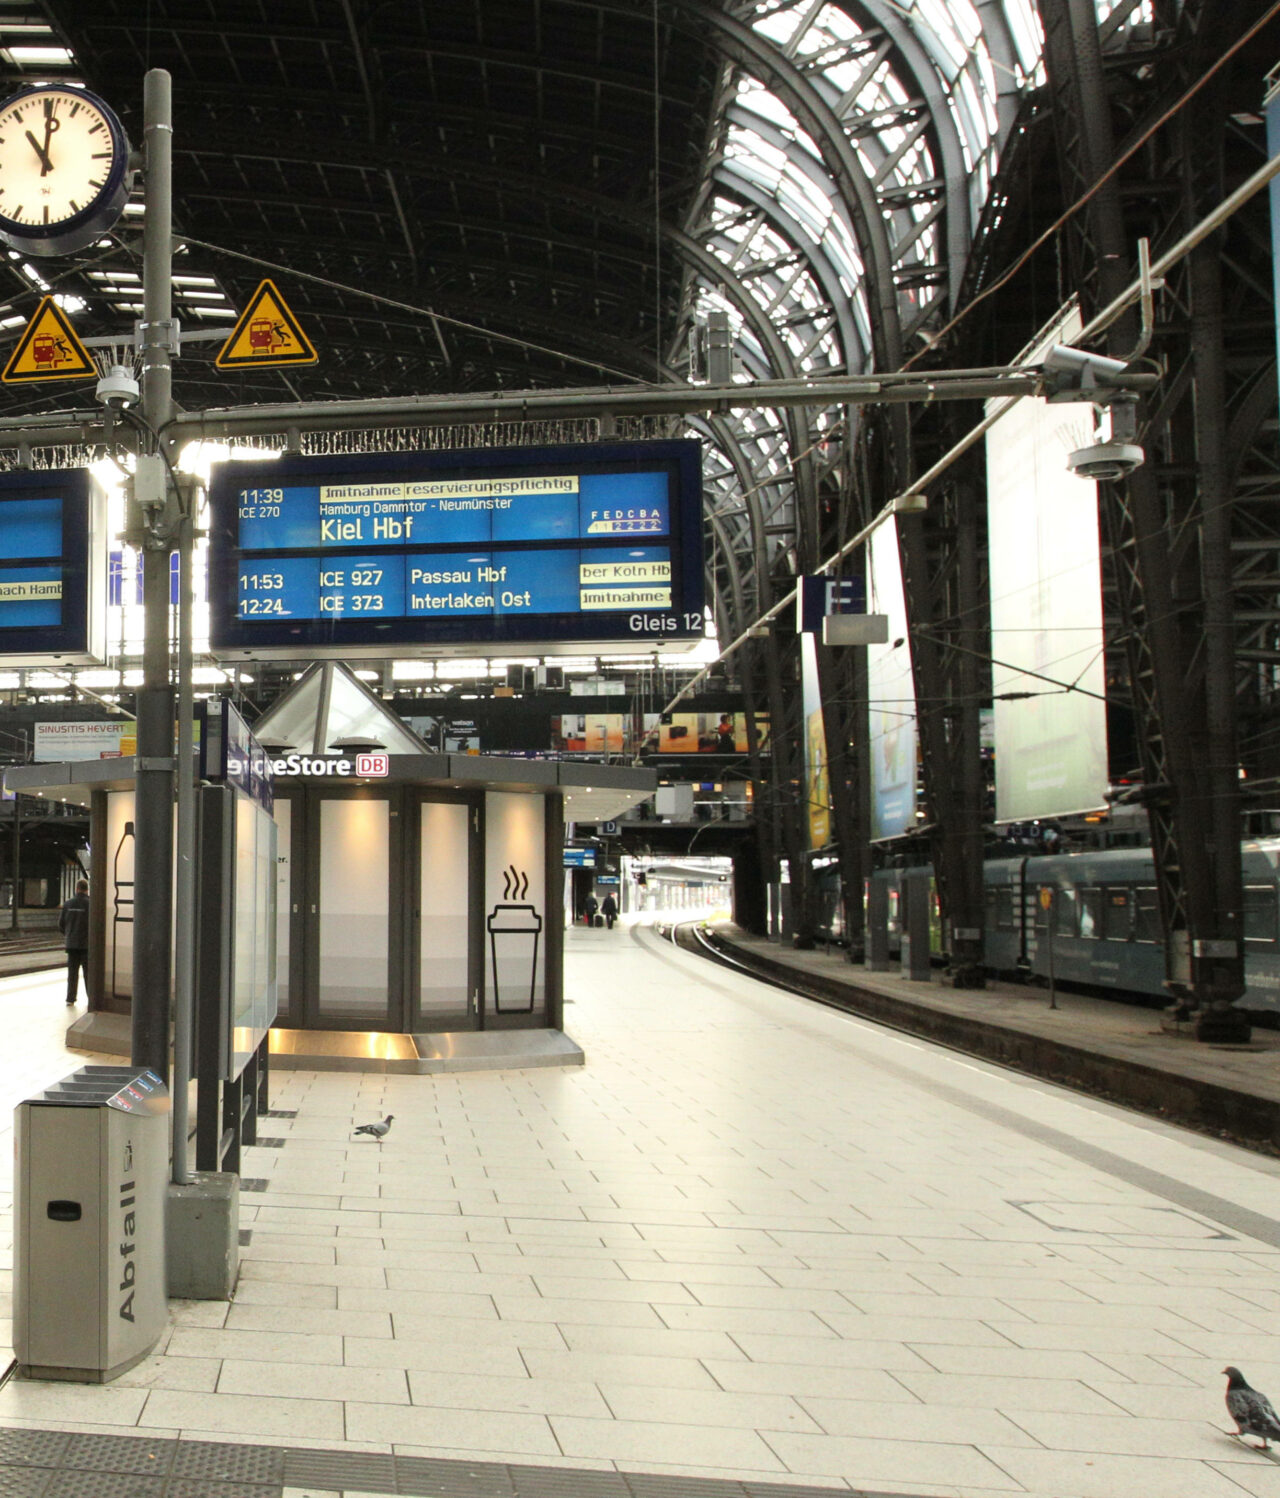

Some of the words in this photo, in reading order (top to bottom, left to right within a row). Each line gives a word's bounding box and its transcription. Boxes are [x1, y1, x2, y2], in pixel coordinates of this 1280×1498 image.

[406, 479, 573, 495] reservierungspflichtig
[240, 488, 284, 504] 11:39
[239, 507, 256, 519] ICE
[259, 506, 280, 518] 270
[320, 504, 370, 517] Hamburg
[373, 502, 427, 514] Dammtor
[440, 498, 513, 511] Neumünster
[591, 511, 598, 520] F
[603, 510, 610, 519] E
[615, 510, 623, 519] D
[627, 510, 635, 518] C
[640, 509, 647, 518] B
[651, 509, 660, 518] A
[321, 518, 363, 541] Kiel
[373, 516, 413, 539] Hbf
[240, 574, 284, 590] 11:53
[320, 571, 345, 587] ICE
[351, 570, 383, 586] 927
[411, 569, 471, 585] Passau
[477, 566, 507, 583] Hbf
[582, 567, 608, 578] ber
[240, 598, 283, 614] 12:24
[320, 596, 345, 612] ICE
[351, 595, 384, 611] 373
[411, 592, 495, 610] Interlaken
[501, 591, 531, 607] Ost
[629, 614, 677, 631] Gleis
[683, 613, 701, 631] 12
[38, 725, 85, 734] SINUSITIS
[87, 724, 125, 733] HEVERT
[361, 758, 384, 773] DB
[607, 821, 616, 832] D
[120, 1180, 135, 1323] Abfall
